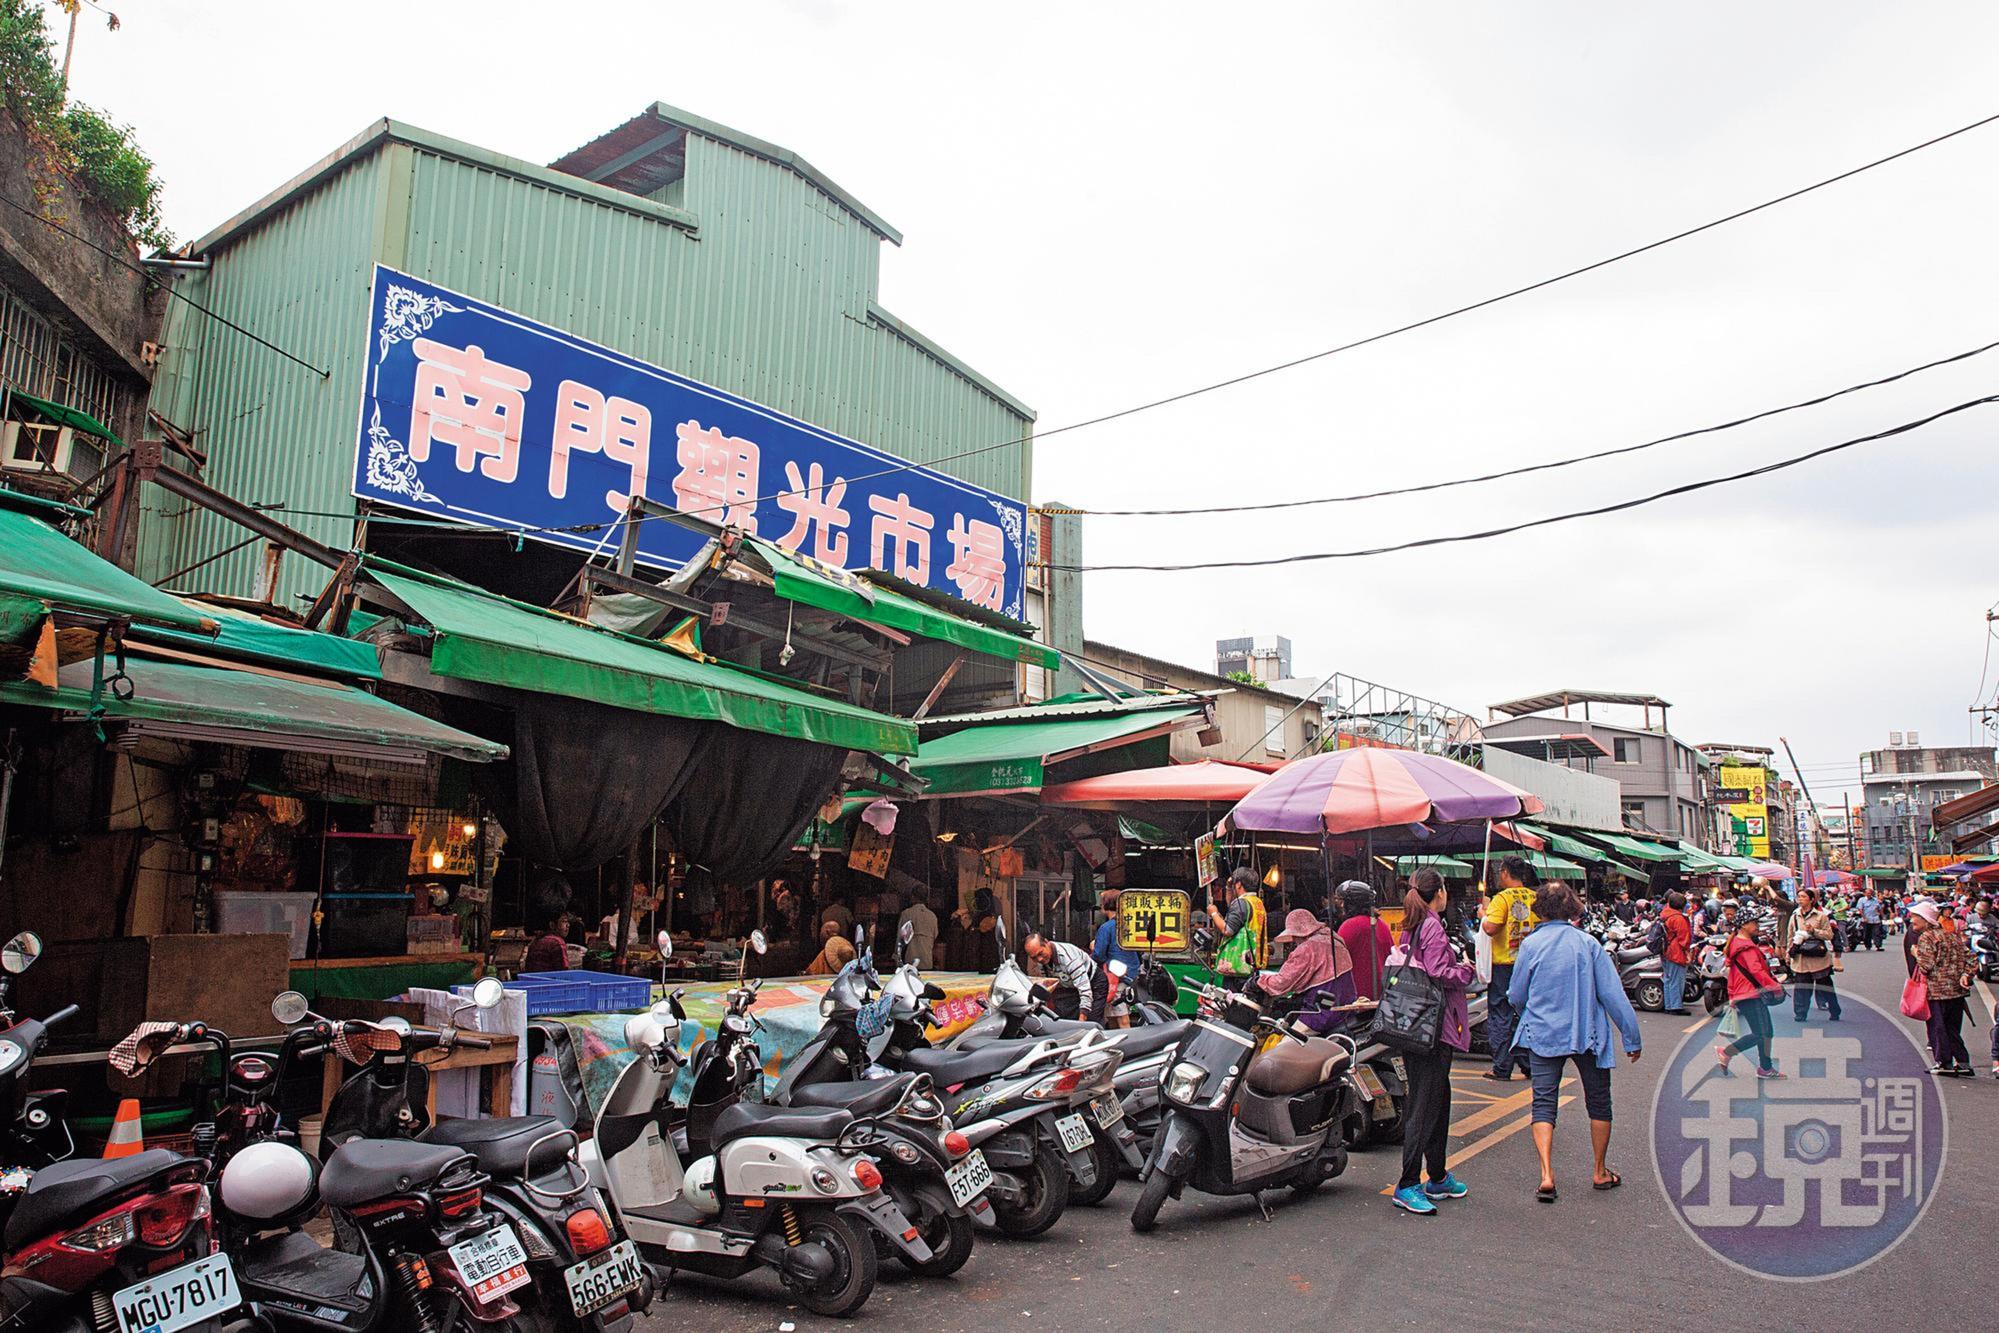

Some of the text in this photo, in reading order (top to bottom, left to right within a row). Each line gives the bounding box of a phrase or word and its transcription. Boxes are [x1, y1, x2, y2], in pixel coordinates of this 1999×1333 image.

[407, 336, 1008, 612] 南門觀光市場
[1125, 895, 1182, 909] 攤販車輛
[1135, 911, 1181, 933] 出口
[951, 1161, 990, 1203] F5T-666
[463, 1244, 522, 1282] 電動自行車
[478, 1267, 527, 1294] 幸福車行
[571, 1255, 641, 1309] 566-EWK
[121, 1267, 228, 1331] MGU-7817
